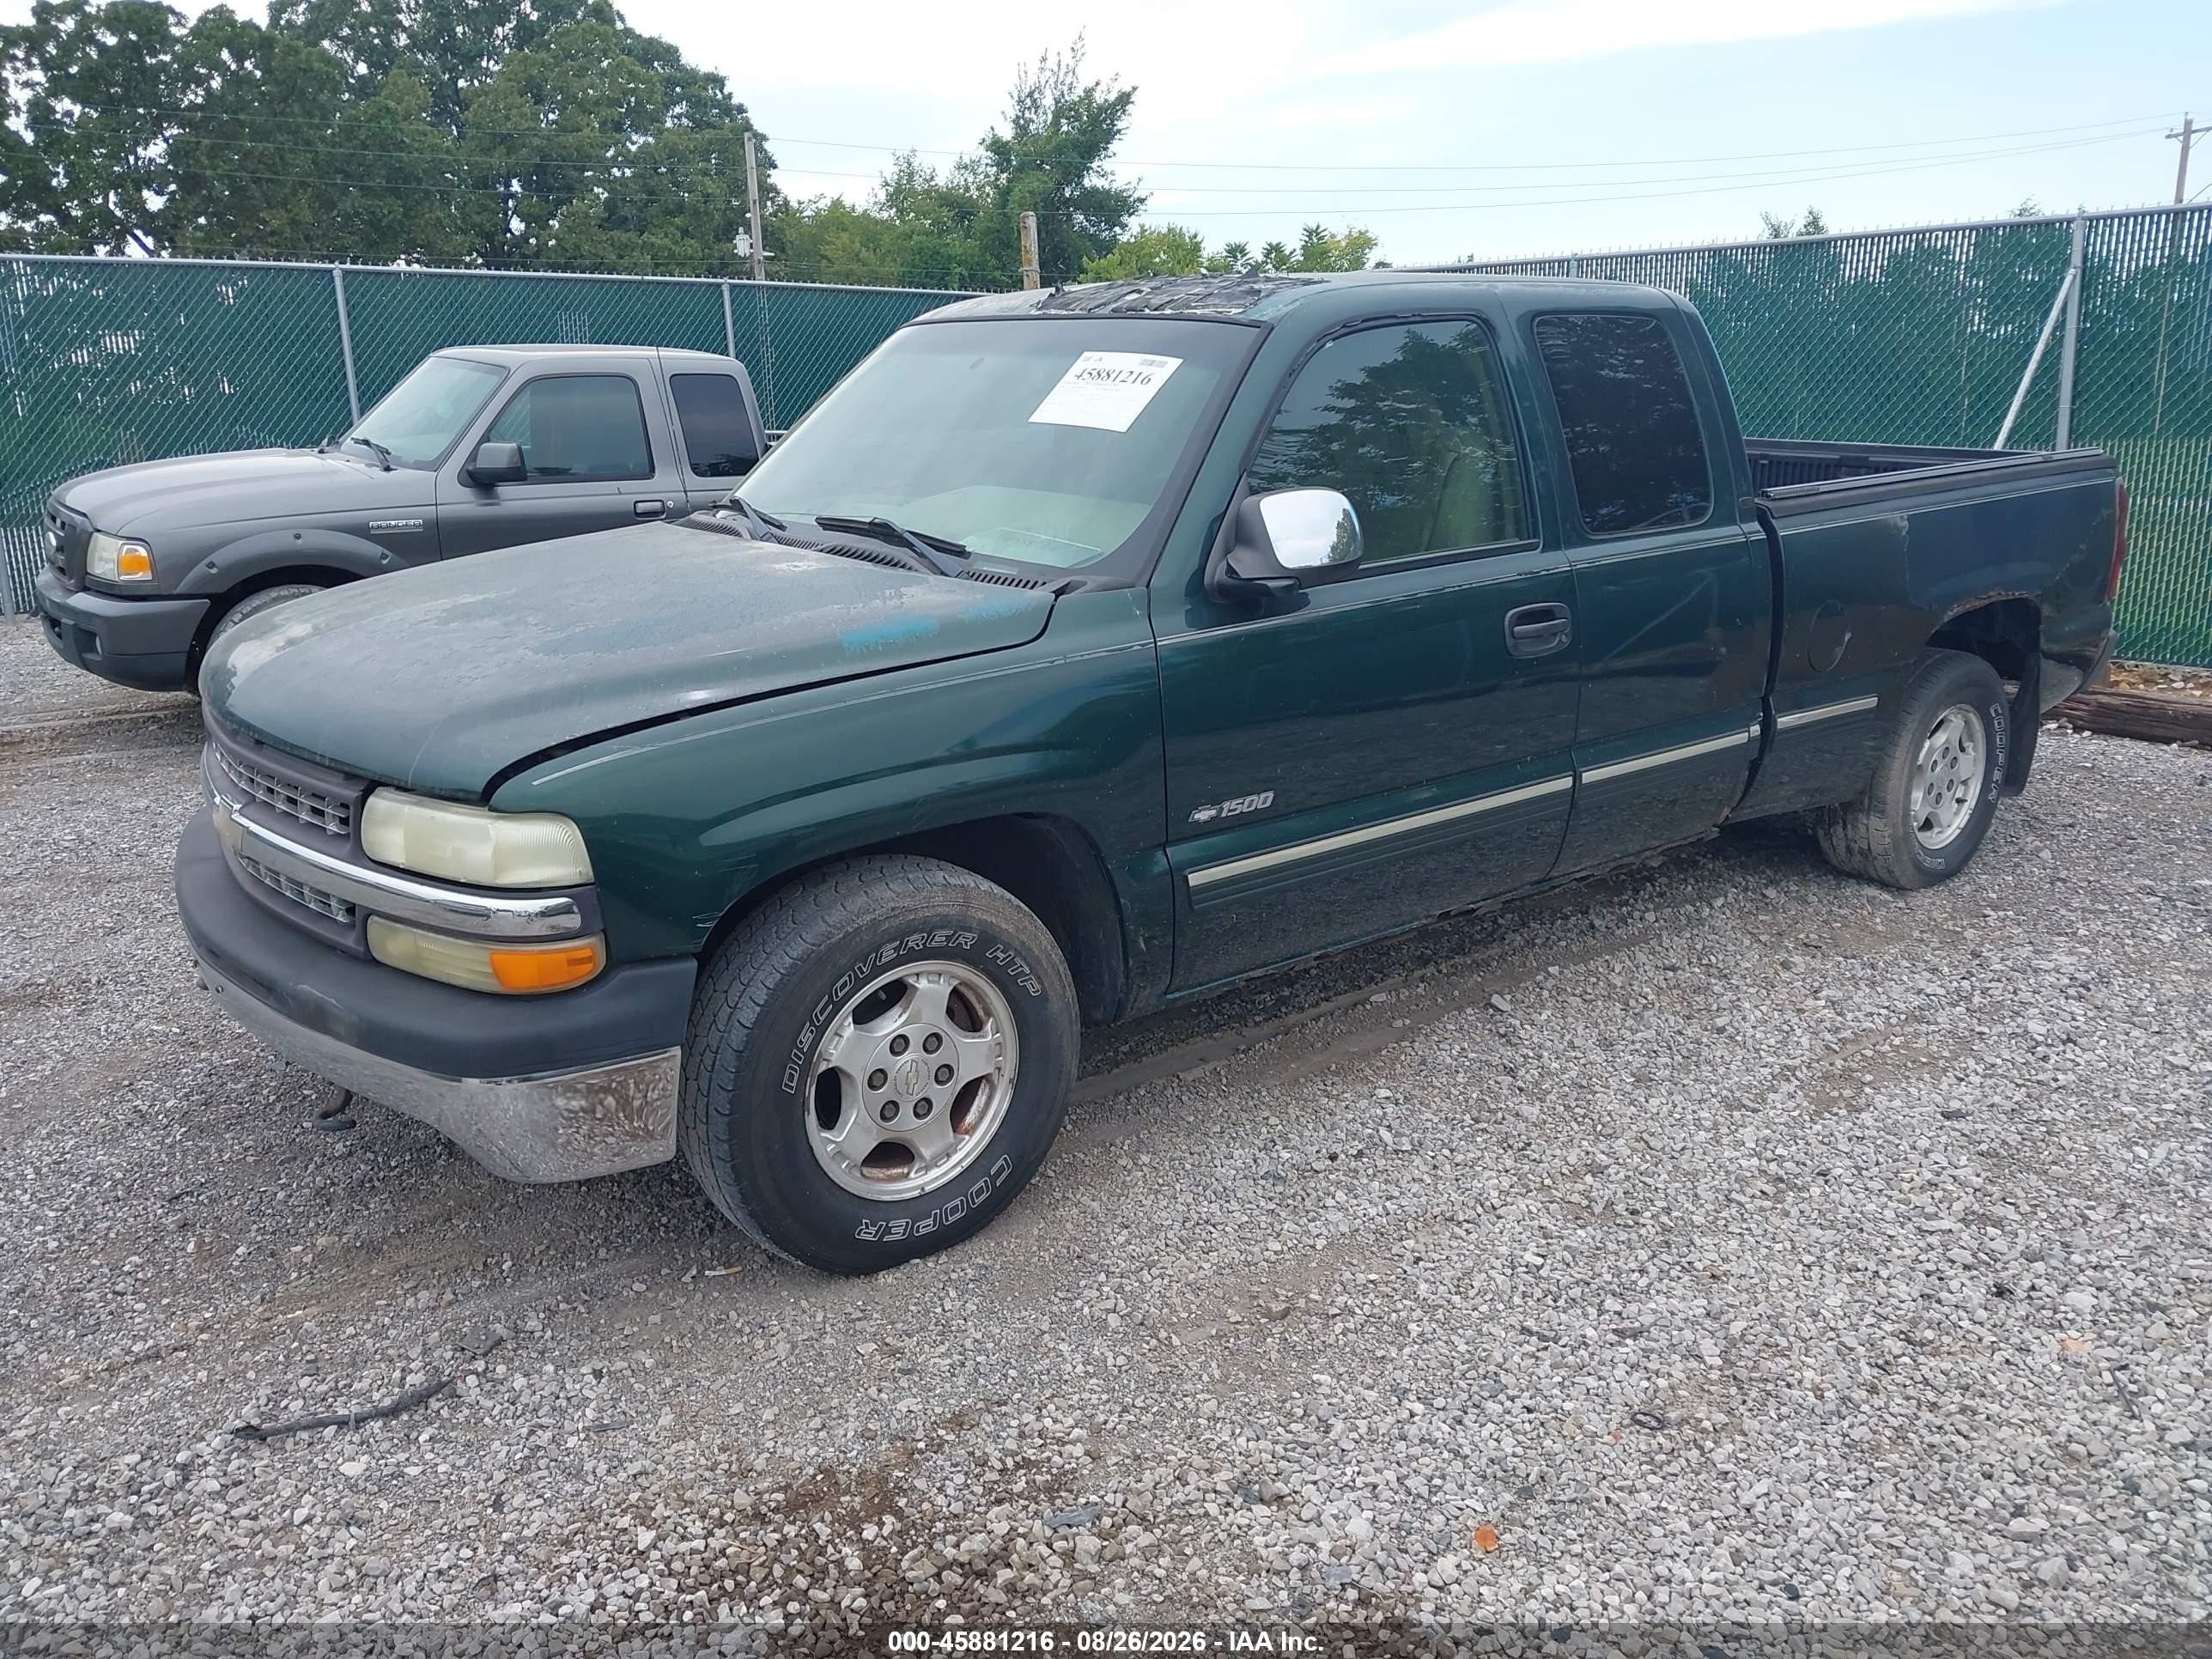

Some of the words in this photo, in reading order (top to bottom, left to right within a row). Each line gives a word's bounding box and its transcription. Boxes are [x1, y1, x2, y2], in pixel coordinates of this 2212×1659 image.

[1074, 368, 1155, 386] 45881216
[1220, 790, 1275, 818] 1500
[781, 930, 979, 1094] DISCOVERER
[986, 944, 1042, 998] HTP
[854, 1154, 1014, 1243] COOPER
